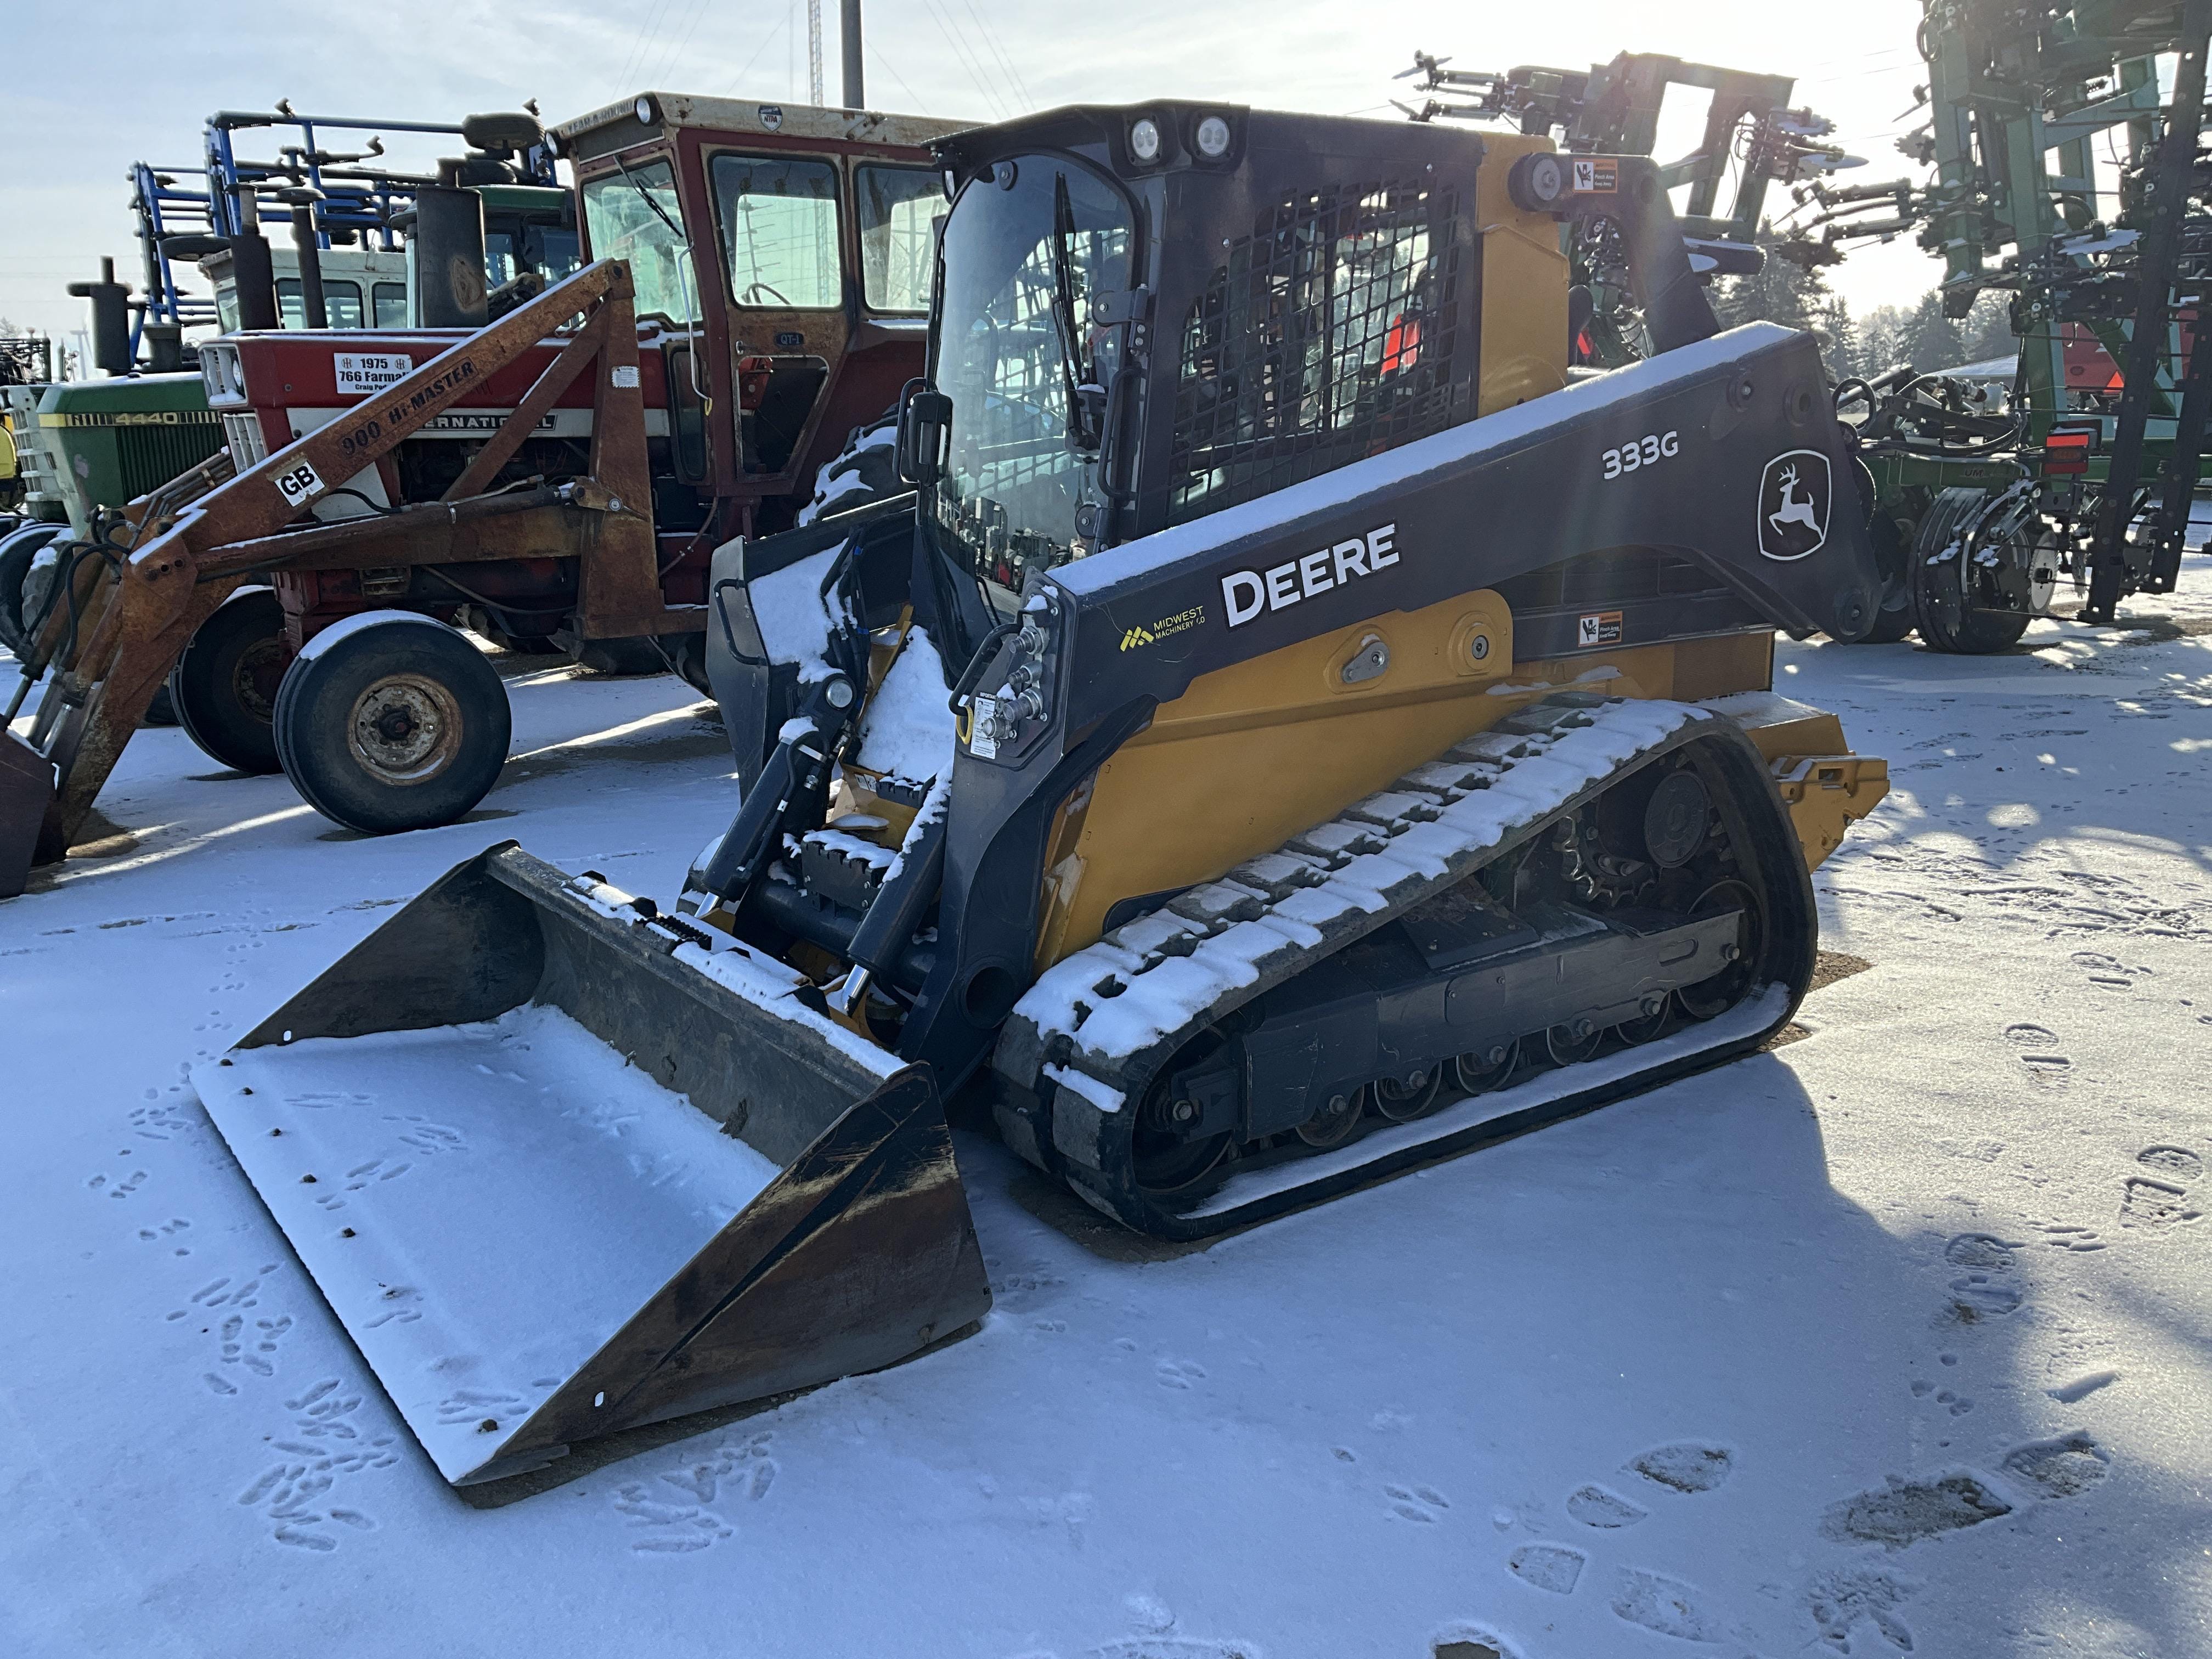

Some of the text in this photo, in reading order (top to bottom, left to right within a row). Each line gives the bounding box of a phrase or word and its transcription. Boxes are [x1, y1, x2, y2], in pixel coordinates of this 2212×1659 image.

[360, 358, 388, 369] 1975
[339, 371, 409, 382] 766 Farma
[115, 413, 178, 425] 4440
[342, 421, 381, 455] 900
[1602, 431, 1679, 479] 333G
[280, 466, 315, 495] GB
[1221, 523, 1400, 628] DEERE
[1154, 606, 1203, 631] MIDWEST
[1155, 620, 1193, 640] MACHINERY
